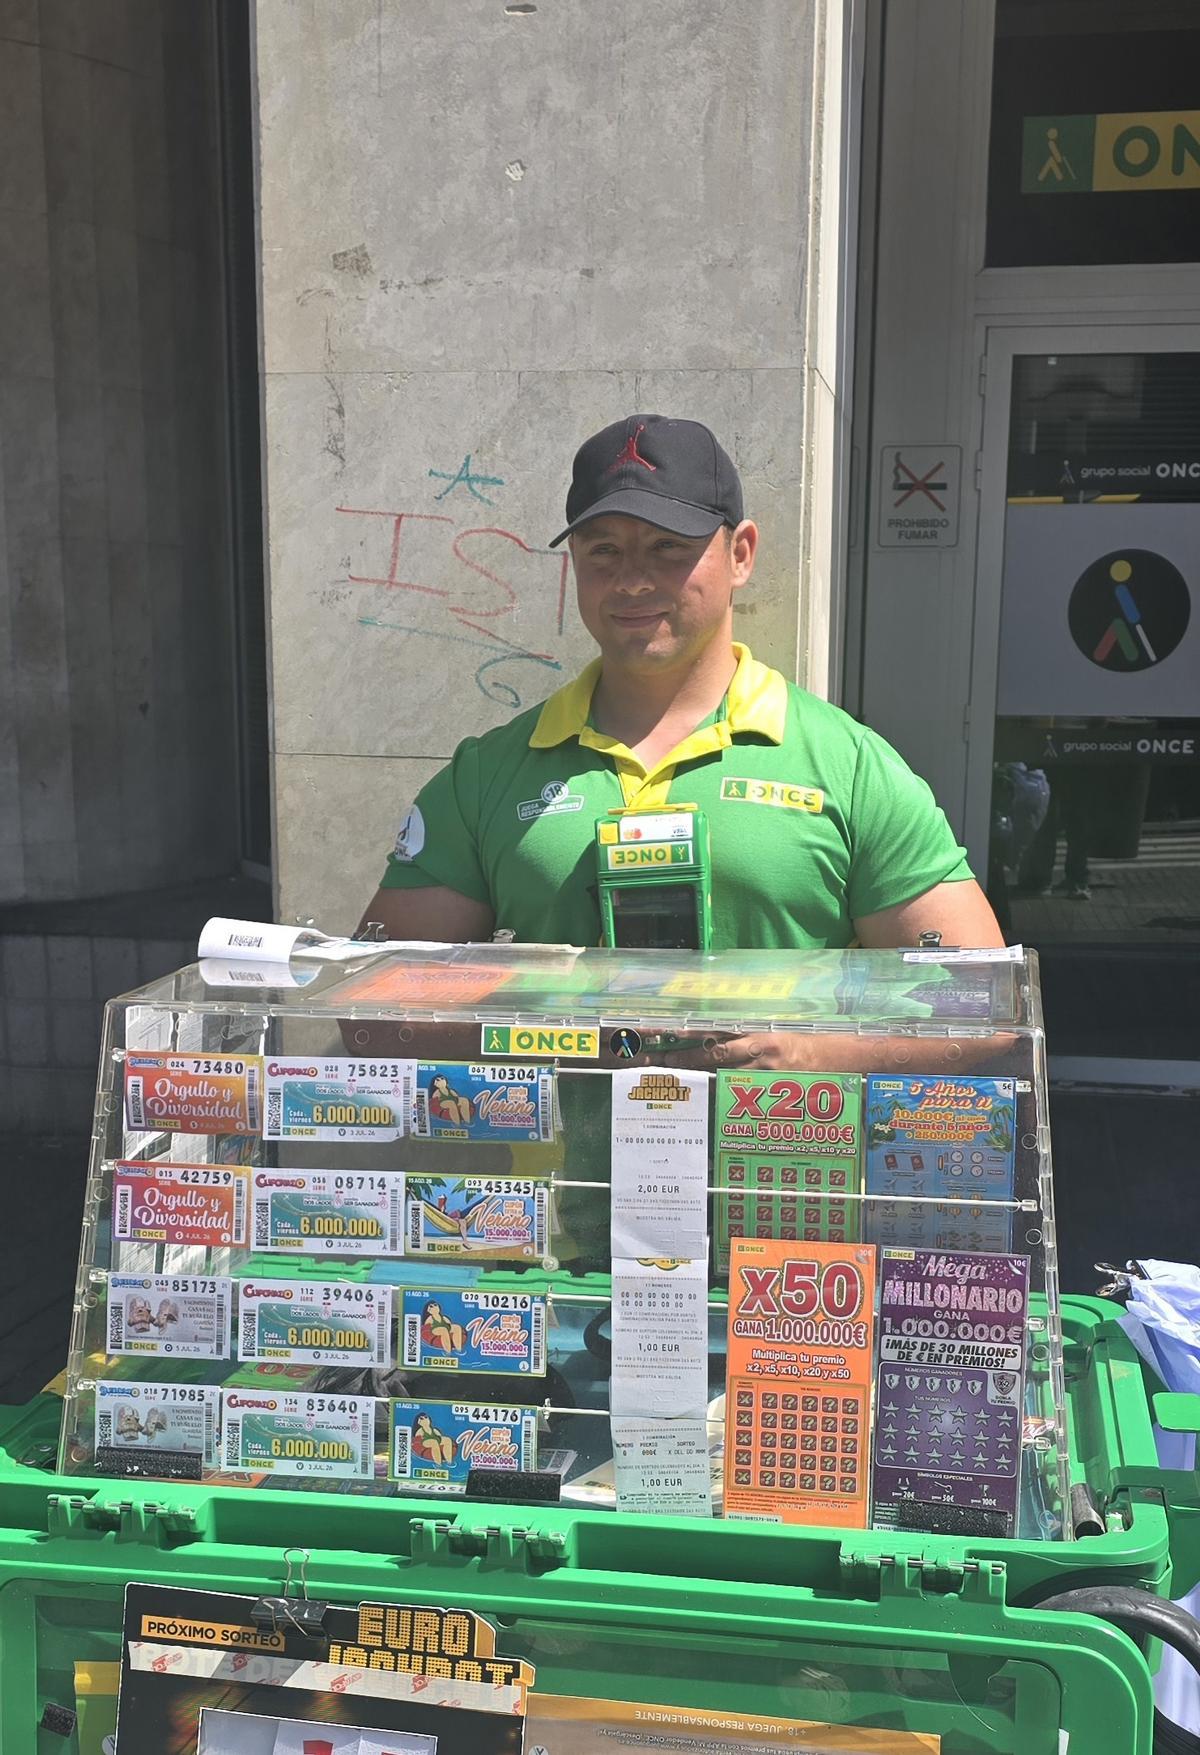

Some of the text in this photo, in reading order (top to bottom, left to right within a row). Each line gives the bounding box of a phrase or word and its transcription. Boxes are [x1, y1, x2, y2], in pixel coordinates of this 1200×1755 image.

[1081, 467, 1116, 479] grupo
[1118, 465, 1150, 476] social
[887, 518, 949, 528] PROHIBIDO
[898, 530, 938, 540] FUMAR
[1064, 739, 1194, 753] grupo social ONCE
[615, 848, 667, 864] ONCE
[517, 1032, 591, 1051] ONCE
[193, 1060, 244, 1075] 73480
[348, 1064, 399, 1078] 75823
[490, 1068, 536, 1082] 10304
[640, 1074, 681, 1087] EURO
[155, 1078, 234, 1103] Orgullo y
[628, 1086, 692, 1102] JACKPOT
[910, 1081, 977, 1097] 5 Años
[146, 1097, 243, 1119] Diversidad
[473, 1086, 536, 1119] Verano
[920, 1096, 973, 1111] para
[313, 1105, 395, 1125] 6.000.000€
[893, 1109, 955, 1121] 10.000€
[292, 1128, 316, 1136] ONCE
[722, 1122, 855, 1144] GANA 500.000€
[889, 1120, 992, 1132] durante 5 años
[720, 1142, 756, 1151] Multiplica
[758, 1143, 766, 1151] tu
[768, 1144, 794, 1154] premio
[180, 1170, 232, 1185] 42759
[335, 1176, 387, 1190] 08714
[484, 1181, 531, 1195] 45345
[638, 1185, 681, 1194] 2,00 EUR
[143, 1187, 222, 1212] Orgullo y
[134, 1205, 230, 1230] Diversidad
[470, 1199, 532, 1233] Verano
[300, 1216, 383, 1237] 6.000.000€
[485, 1229, 530, 1237] 15.000.000€
[142, 1230, 165, 1238] ONCE
[437, 1244, 461, 1252] ONCE
[922, 1255, 988, 1285] Mega
[1013, 1259, 1026, 1267] 10€
[172, 1280, 216, 1294] 85173
[323, 1287, 374, 1302] 39406
[882, 1280, 1024, 1314] MILLONARIO
[484, 1295, 528, 1309] 10216
[933, 1310, 971, 1321] GANA
[467, 1313, 529, 1348] Verano
[734, 1318, 866, 1347] GANA 1.000.000€
[882, 1317, 1023, 1345] 1.000.000€
[288, 1327, 369, 1349] 6.000.000€
[482, 1343, 527, 1352] 15.000.000€
[638, 1343, 680, 1353] 1,00 EUR
[885, 1337, 1018, 1359] ¡MÁS DE 30 MILLONES
[433, 1358, 457, 1366] ONCE
[752, 1349, 845, 1365] Multiplica tu premio
[896, 1351, 1006, 1368] DE € EN PREMIOS!
[747, 1363, 850, 1379] x2, x5, x10, x20 y x50
[161, 1388, 205, 1402] 71985
[306, 1398, 358, 1414] 83640
[472, 1408, 518, 1422] 44176
[271, 1438, 353, 1460] 6.000.000€
[457, 1427, 519, 1461] Verano
[472, 1456, 517, 1465] 15.000.000€
[424, 1470, 447, 1478] ONCE
[641, 1478, 683, 1488] 1,00 EUR
[903, 1490, 916, 1499] 20€
[942, 1494, 955, 1502] 50€
[981, 1498, 997, 1507] 100€
[147, 1619, 281, 1647] PRÓXIMO SORTEO
[358, 1605, 470, 1657] EURO
[635, 1711, 807, 1737] +18. JUEGA RESPONSABLEMENTE
[741, 1744, 766, 1754] premios
